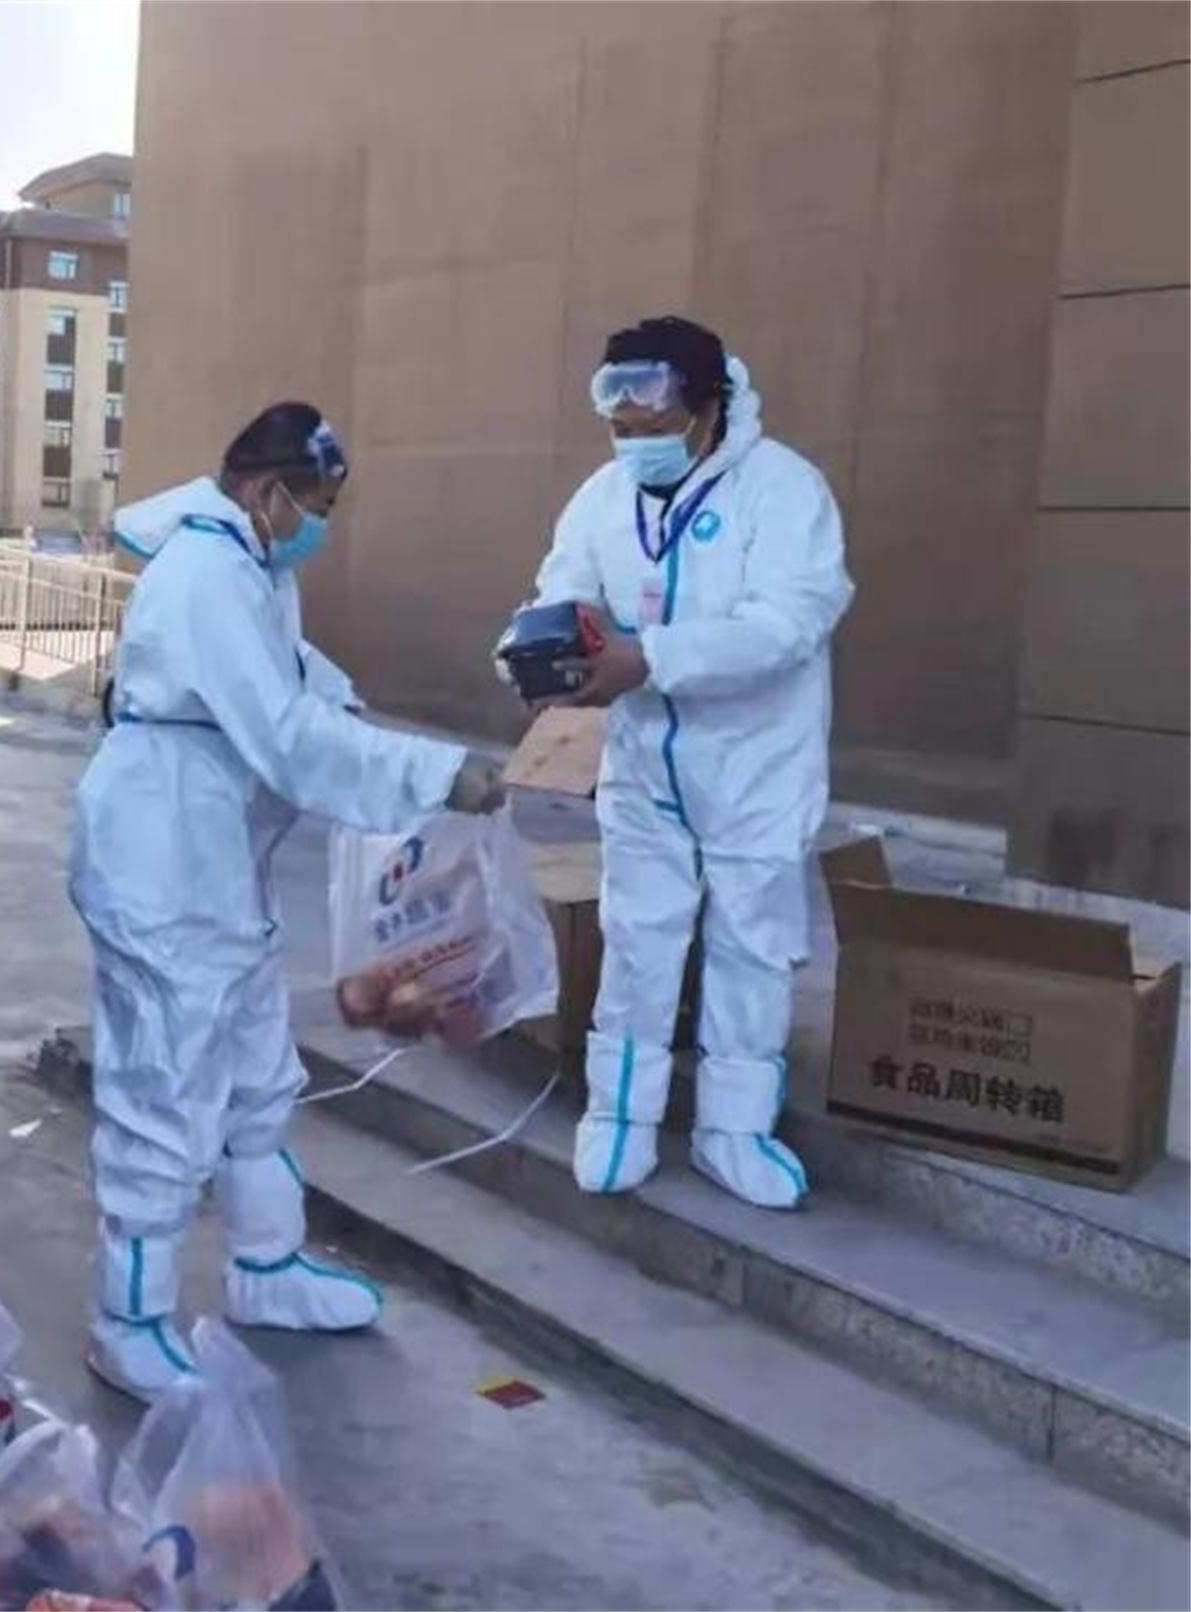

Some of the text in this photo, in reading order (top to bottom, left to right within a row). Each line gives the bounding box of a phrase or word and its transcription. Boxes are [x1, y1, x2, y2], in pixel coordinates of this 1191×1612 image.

[869, 1053, 1066, 1124] 食品周转箱
